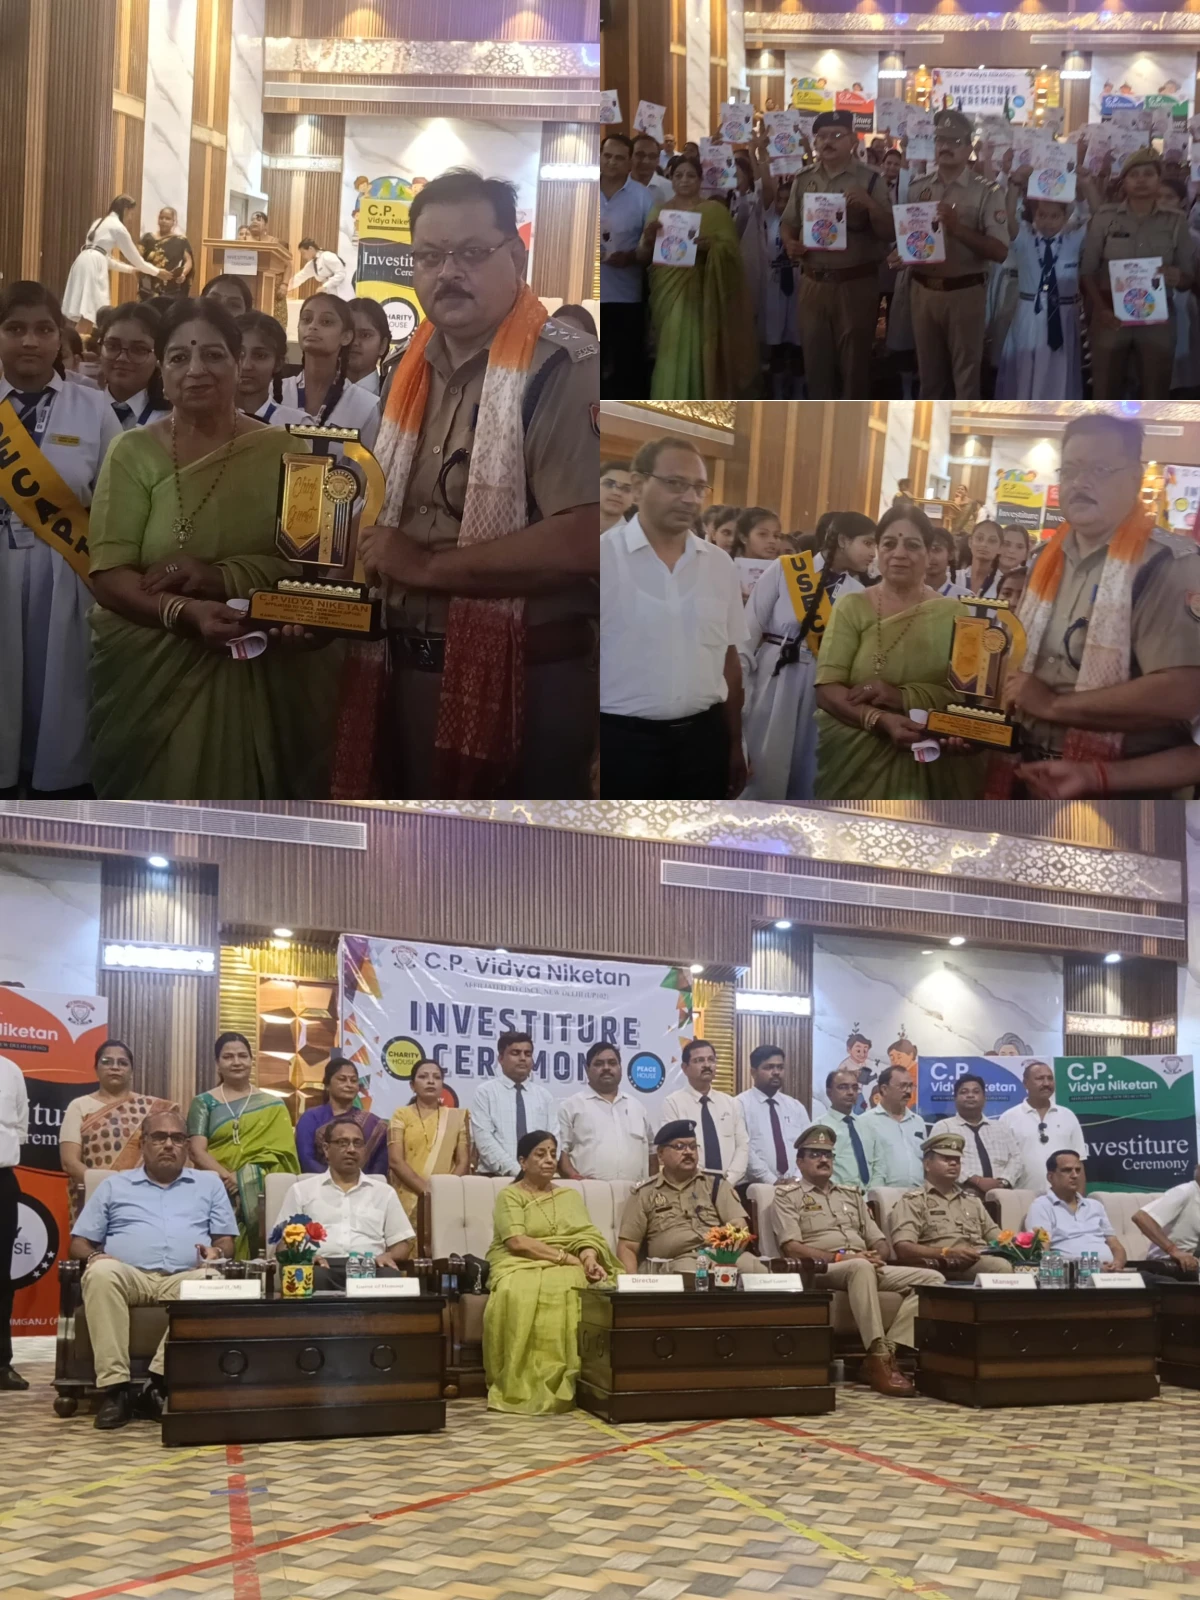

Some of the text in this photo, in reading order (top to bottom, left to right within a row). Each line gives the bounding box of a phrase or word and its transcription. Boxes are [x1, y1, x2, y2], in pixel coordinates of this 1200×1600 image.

[950, 84, 1018, 95] INVESTITURE
[368, 204, 396, 217] C.P.
[368, 217, 390, 225] Vidya
[363, 251, 414, 267] Investit
[394, 267, 414, 277] Cere
[389, 321, 408, 329] OUSE
[11, 467, 90, 557] CAPT
[790, 557, 816, 613] USE
[280, 595, 315, 607] VIDYA
[317, 600, 369, 613] NIKETAN
[424, 951, 468, 973] C.P.
[547, 962, 631, 987] Niketan
[410, 1000, 639, 1046] INVESTITURE
[388, 1050, 420, 1059] CHARITY
[432, 1043, 588, 1081] CERMON
[637, 1065, 657, 1073] PEACE
[1067, 1062, 1114, 1081] C.P.
[930, 1082, 1017, 1095] Vidy ketan
[1068, 1080, 1158, 1095] Vidya Niketan
[1084, 1134, 1189, 1157] vestiture
[1122, 1157, 1190, 1172] Ceremony
[992, 1278, 1020, 1286] Manager
[9, 1317, 48, 1327] IMGANJ
